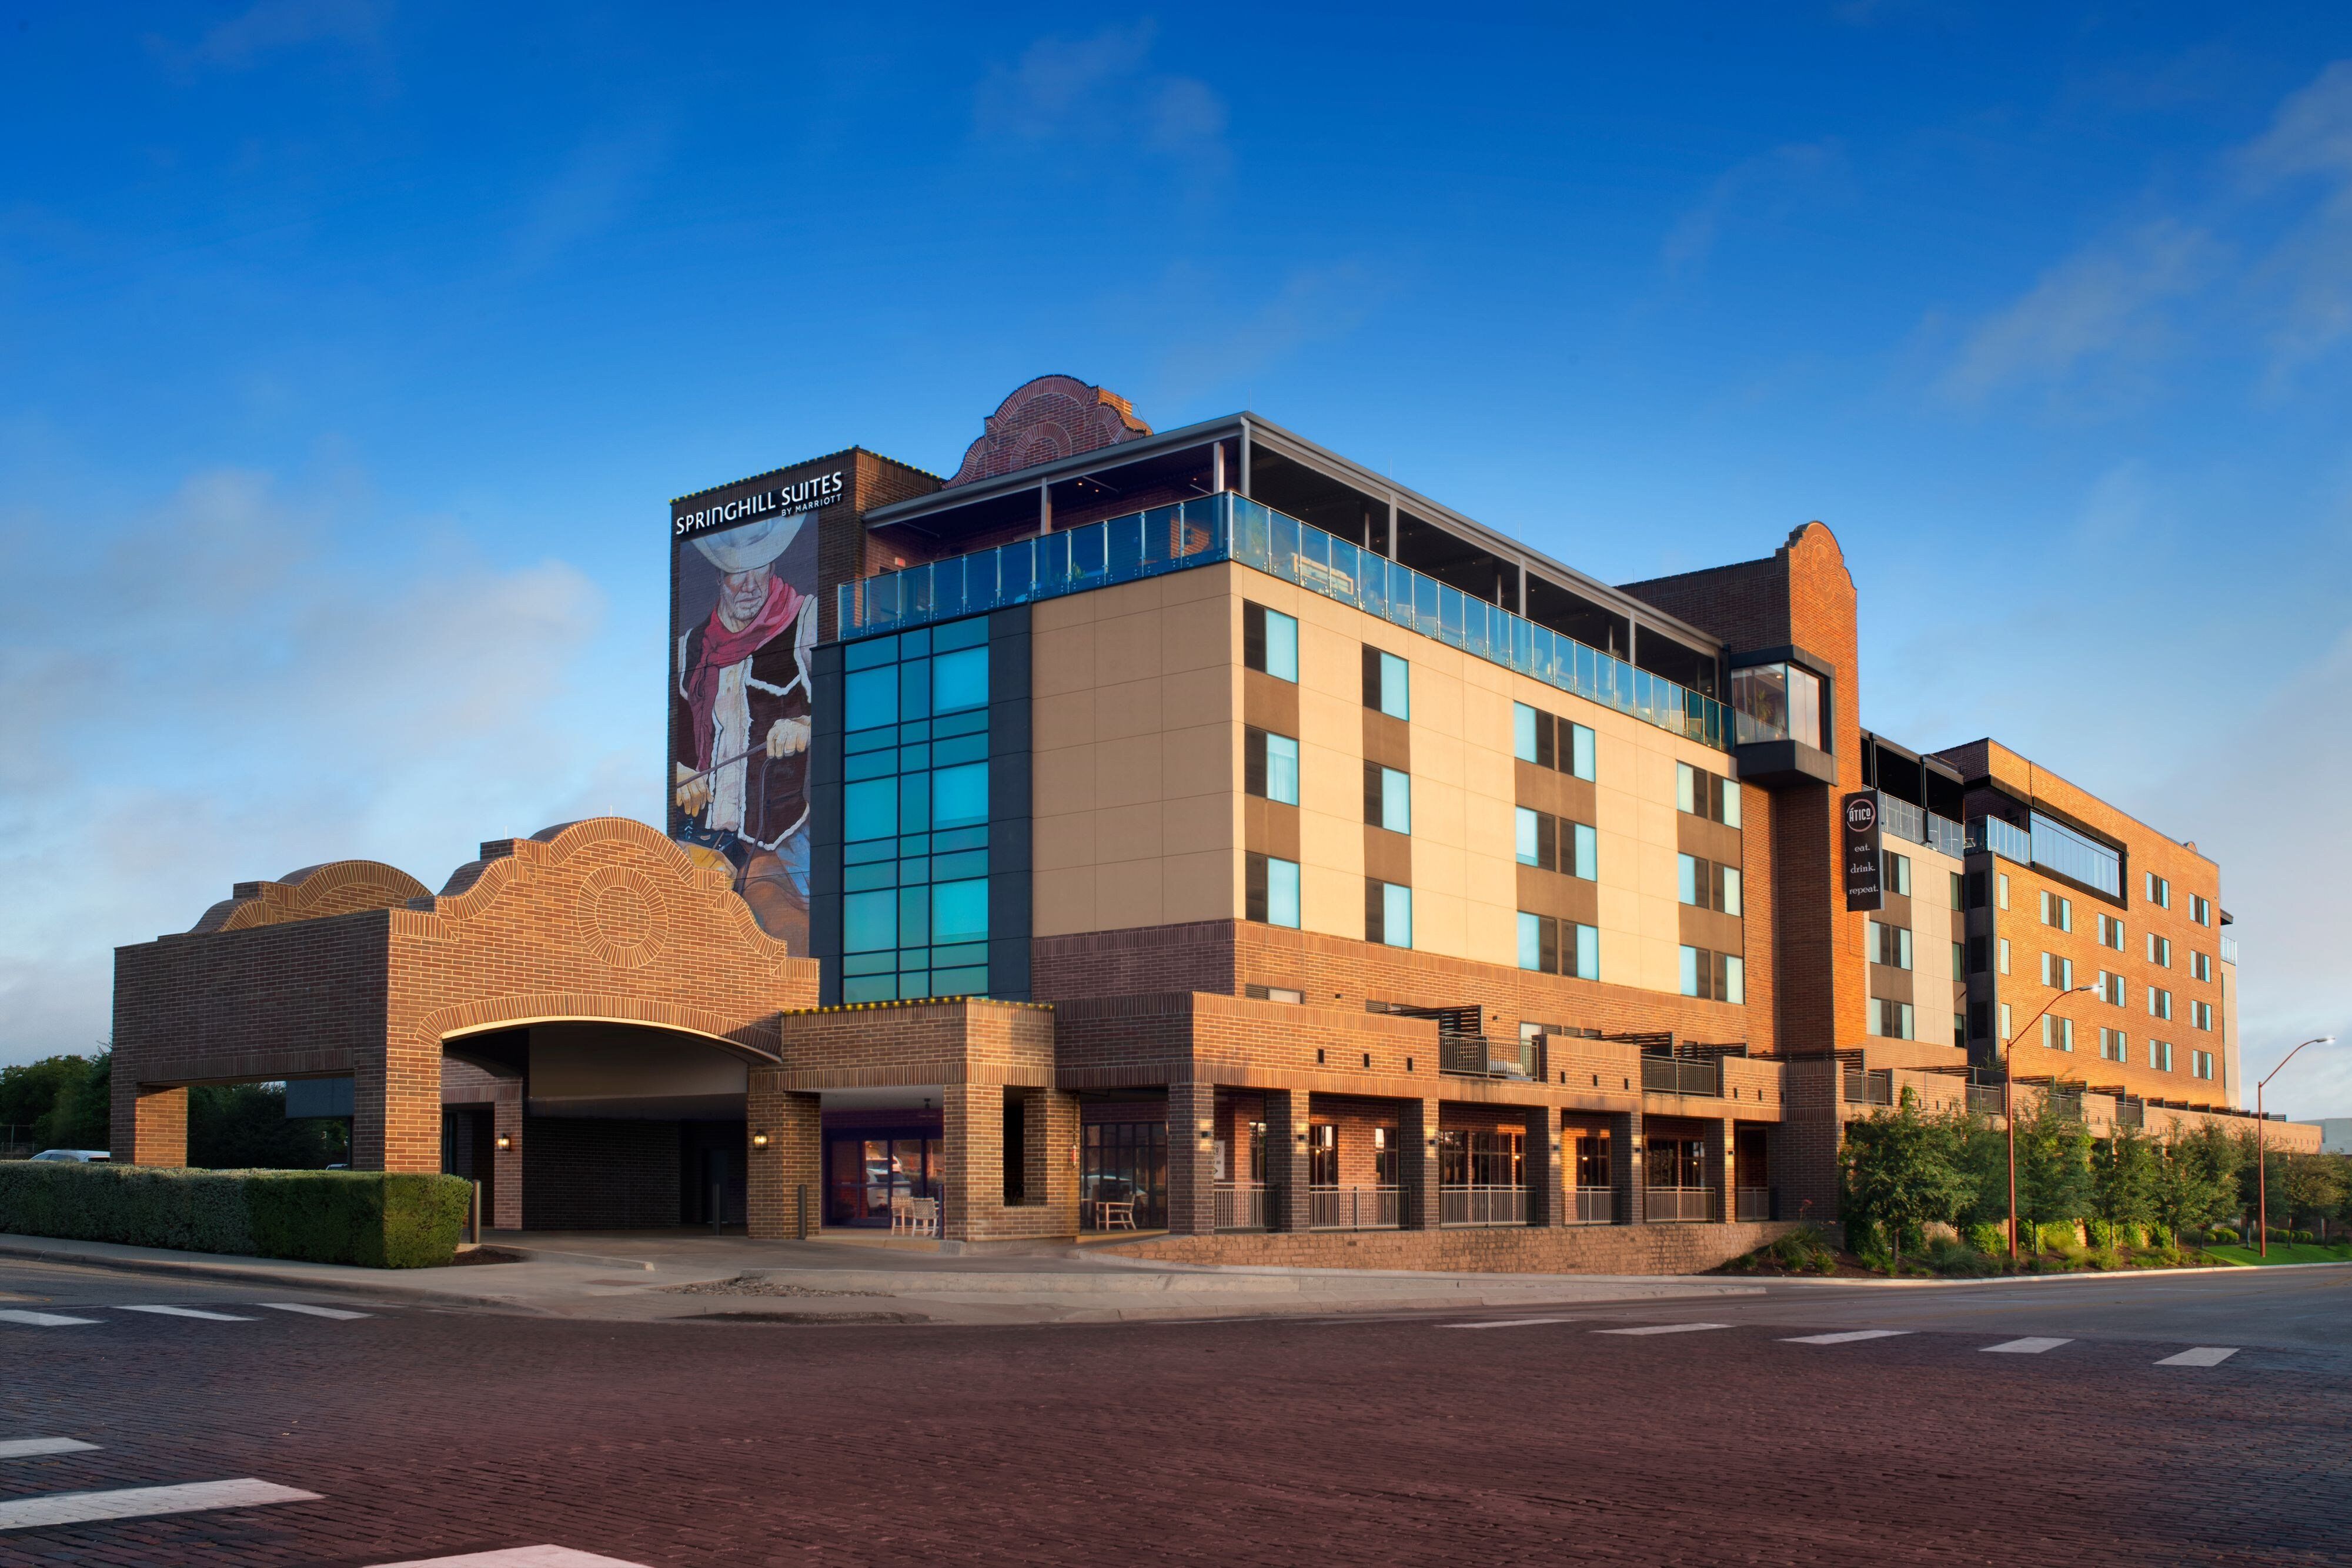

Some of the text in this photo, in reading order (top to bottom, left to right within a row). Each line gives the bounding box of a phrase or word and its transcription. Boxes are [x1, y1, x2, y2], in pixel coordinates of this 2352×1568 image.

[676, 472, 843, 534] SPRINGHILL SUITES
[781, 494, 841, 517] BY MARRIOTT
[1854, 843, 1870, 852] eat.
[1850, 862, 1876, 874] drink.
[1849, 884, 1879, 895] repeat.
